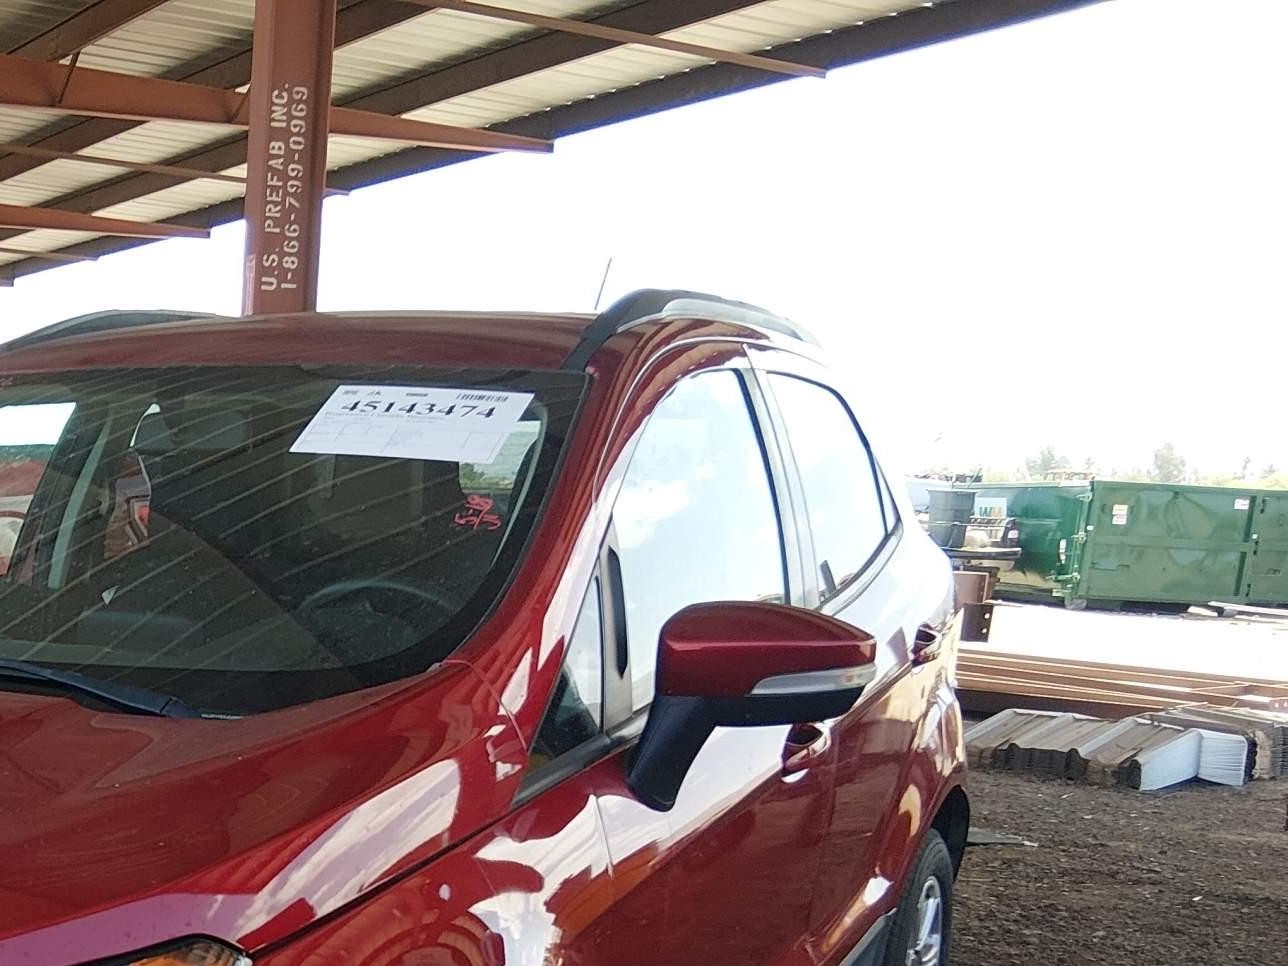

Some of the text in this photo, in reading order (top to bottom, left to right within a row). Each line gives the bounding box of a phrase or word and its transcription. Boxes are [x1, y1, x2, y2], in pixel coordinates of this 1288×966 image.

[261, 83, 289, 291] U.S. PREFAB INC.
[281, 85, 308, 289] 1-866-799-0969
[341, 399, 497, 419] 45143474
